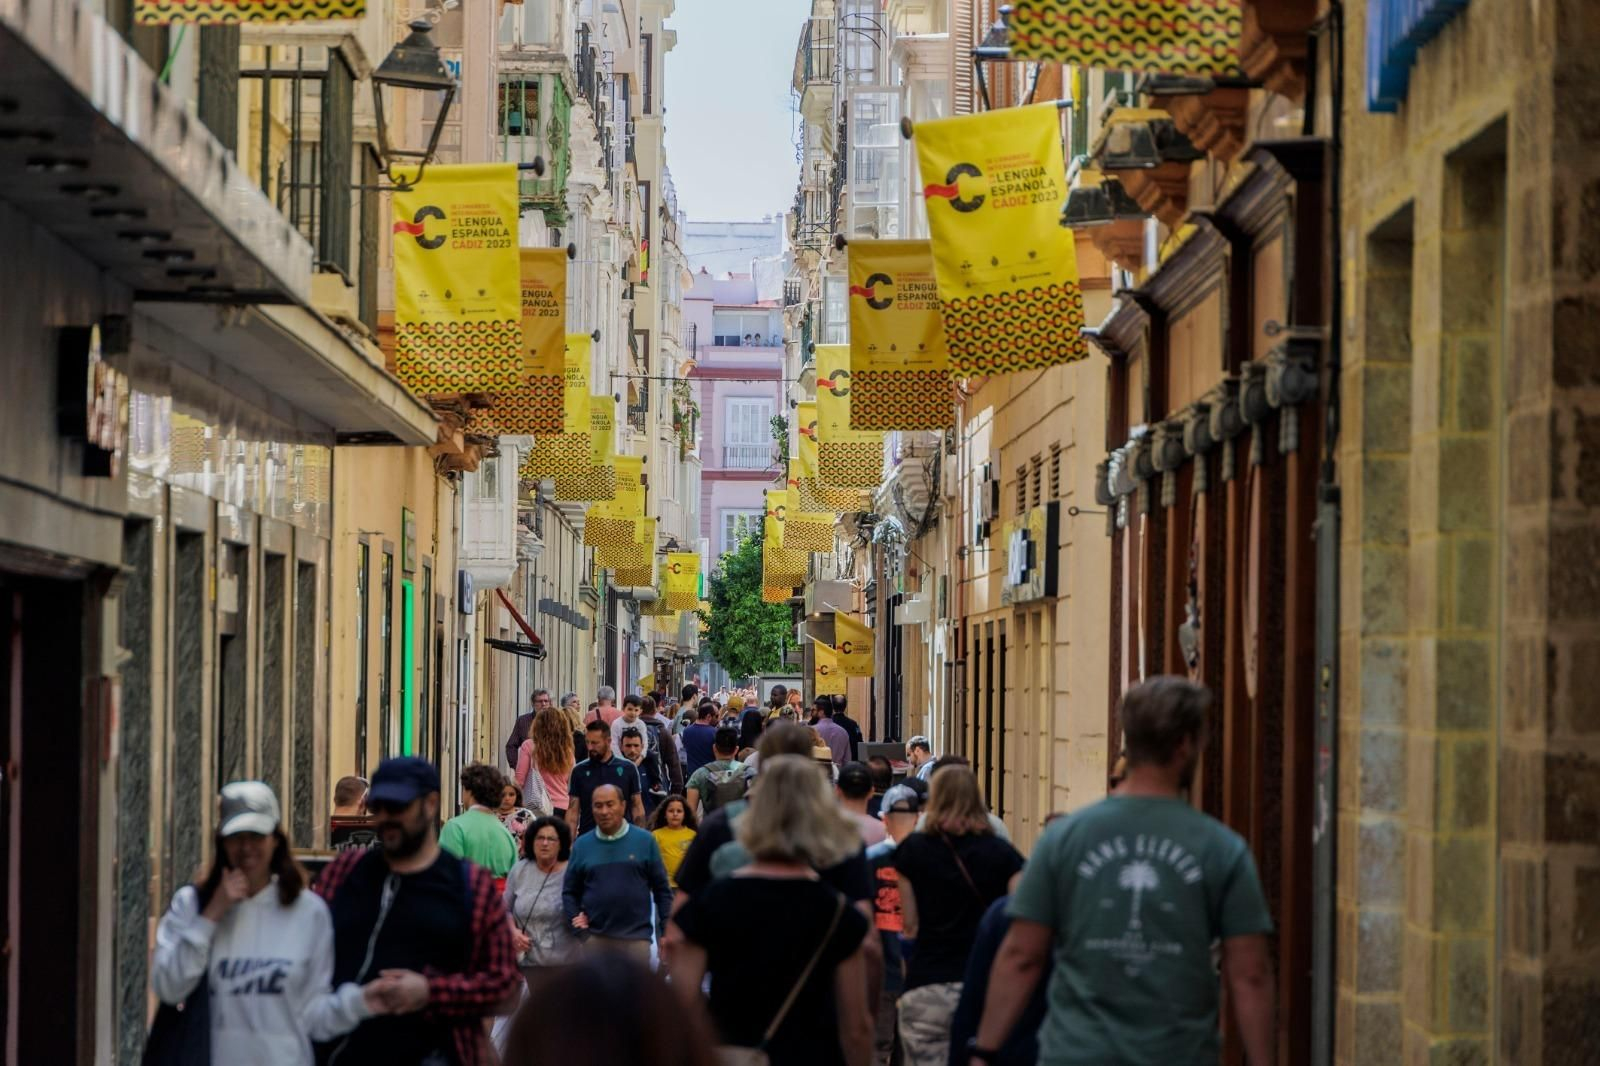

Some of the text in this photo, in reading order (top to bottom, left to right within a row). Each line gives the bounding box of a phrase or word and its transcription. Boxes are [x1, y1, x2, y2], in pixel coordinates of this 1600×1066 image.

[995, 166, 1047, 184] LENGUA
[1031, 191, 1059, 204] 2023
[458, 217, 503, 227] LENGUA
[486, 239, 511, 249] 2023
[521, 290, 553, 299] ENGUA
[897, 292, 940, 301] ESPAÑOL
[522, 299, 559, 308] PAÑOLA
[926, 301, 940, 310] 202
[522, 308, 560, 317] DIZ 2023
